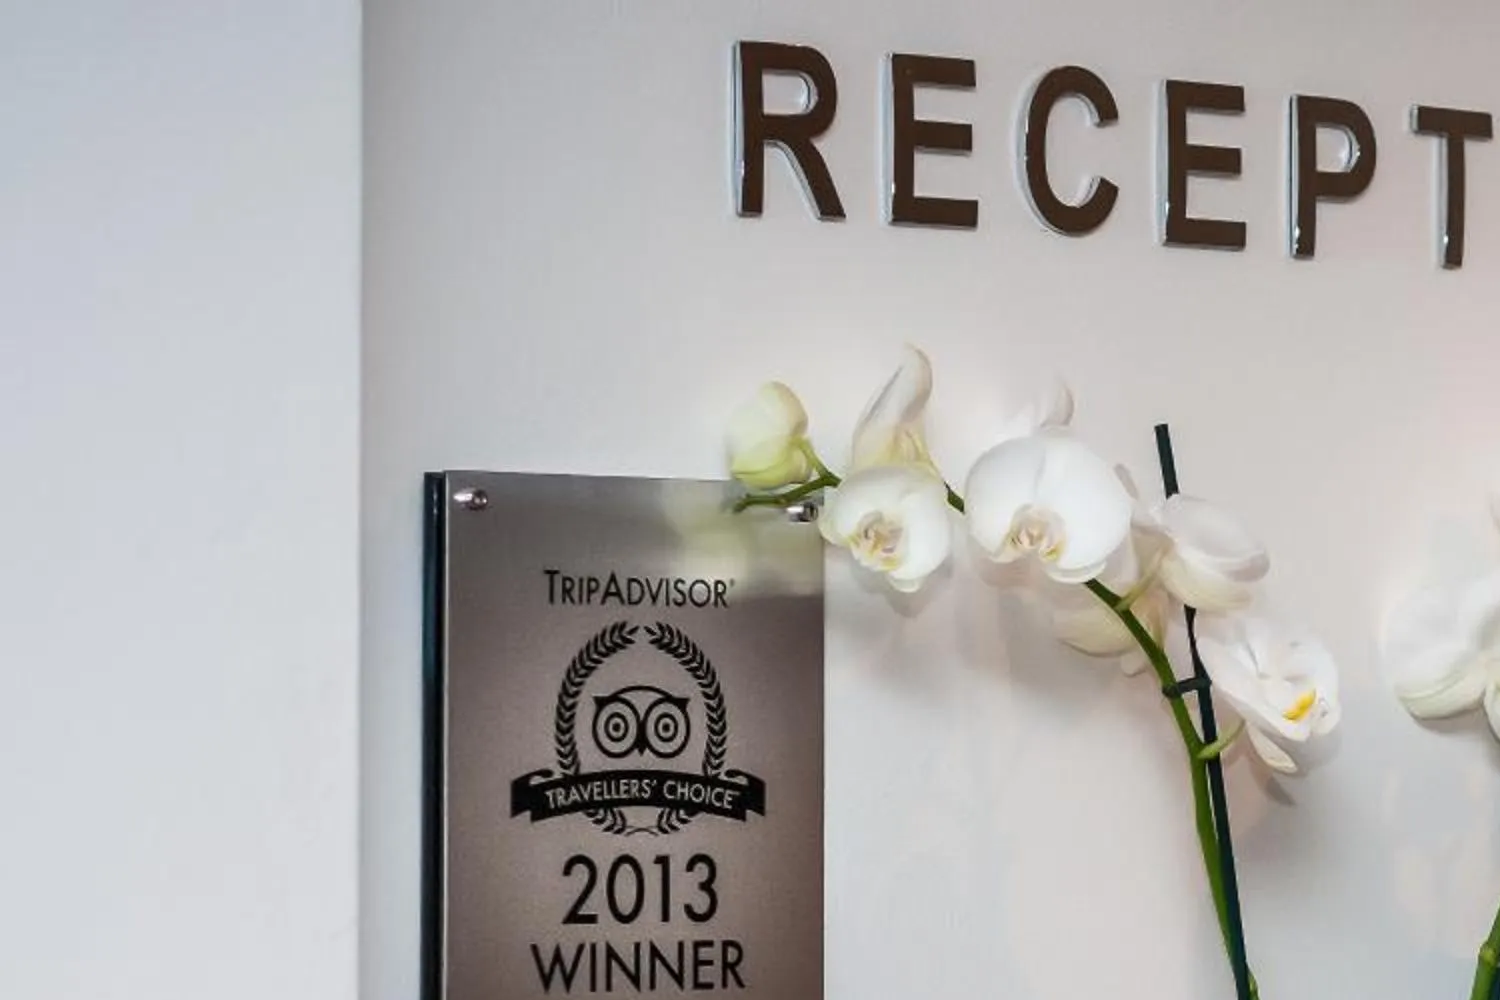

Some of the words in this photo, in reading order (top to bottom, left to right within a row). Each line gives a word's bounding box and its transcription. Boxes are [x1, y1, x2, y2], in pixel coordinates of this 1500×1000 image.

[663, 780, 740, 809] CHOICE
[562, 854, 719, 925] 2013
[530, 940, 746, 994] WINNER
